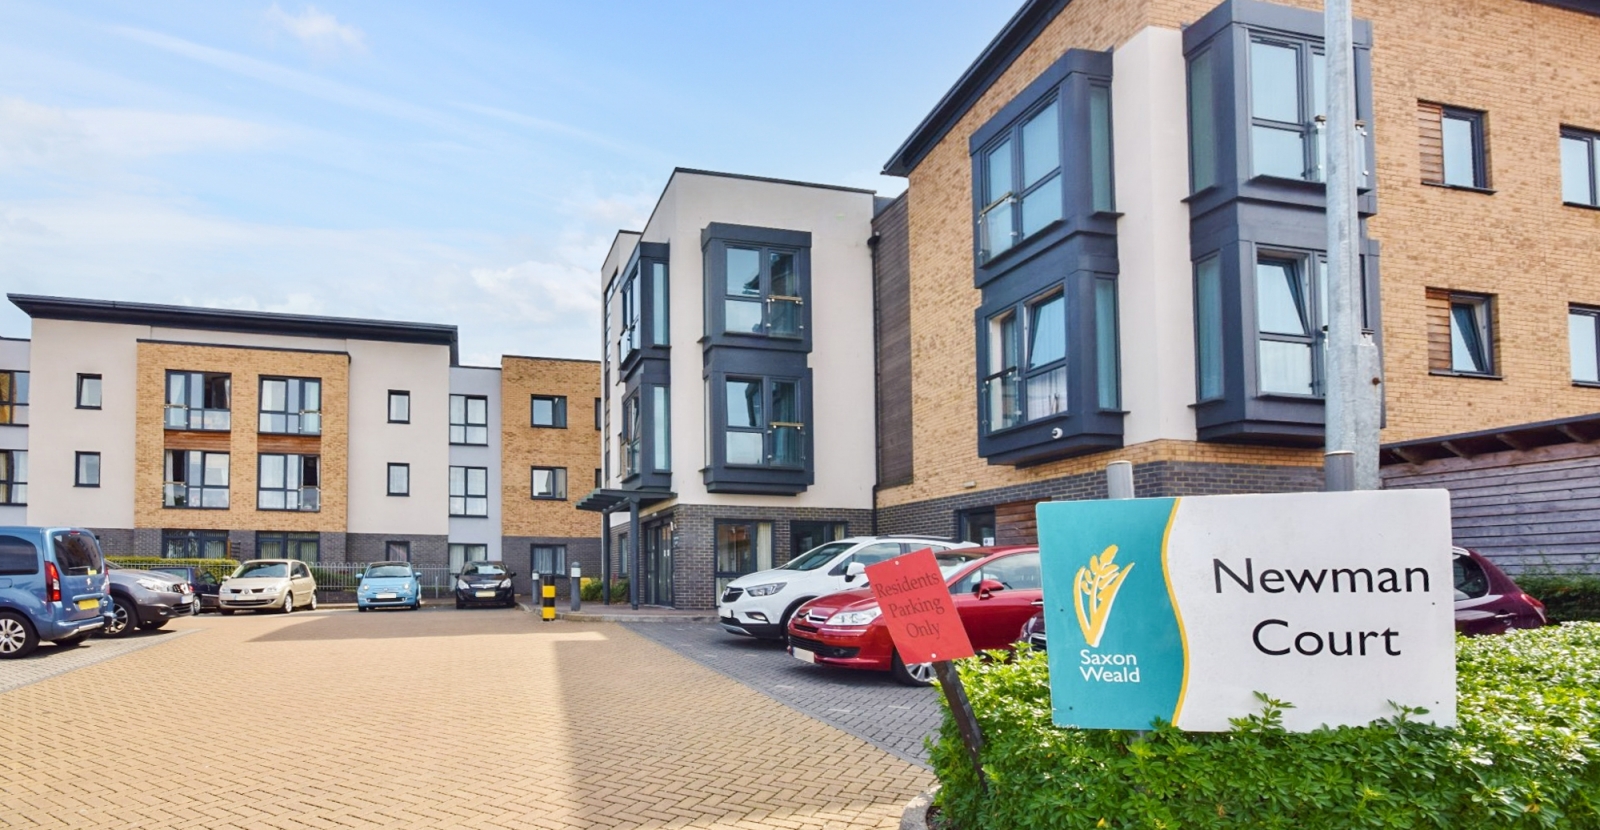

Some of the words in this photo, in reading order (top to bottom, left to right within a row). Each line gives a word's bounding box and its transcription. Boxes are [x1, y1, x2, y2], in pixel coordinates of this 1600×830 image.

[875, 572, 940, 598] Residents
[1213, 557, 1430, 594] Newman
[888, 597, 945, 618] Parking
[906, 620, 941, 640] Only
[1252, 618, 1402, 657] Court
[1080, 649, 1137, 666] Saxon
[1079, 666, 1140, 683] Weald
